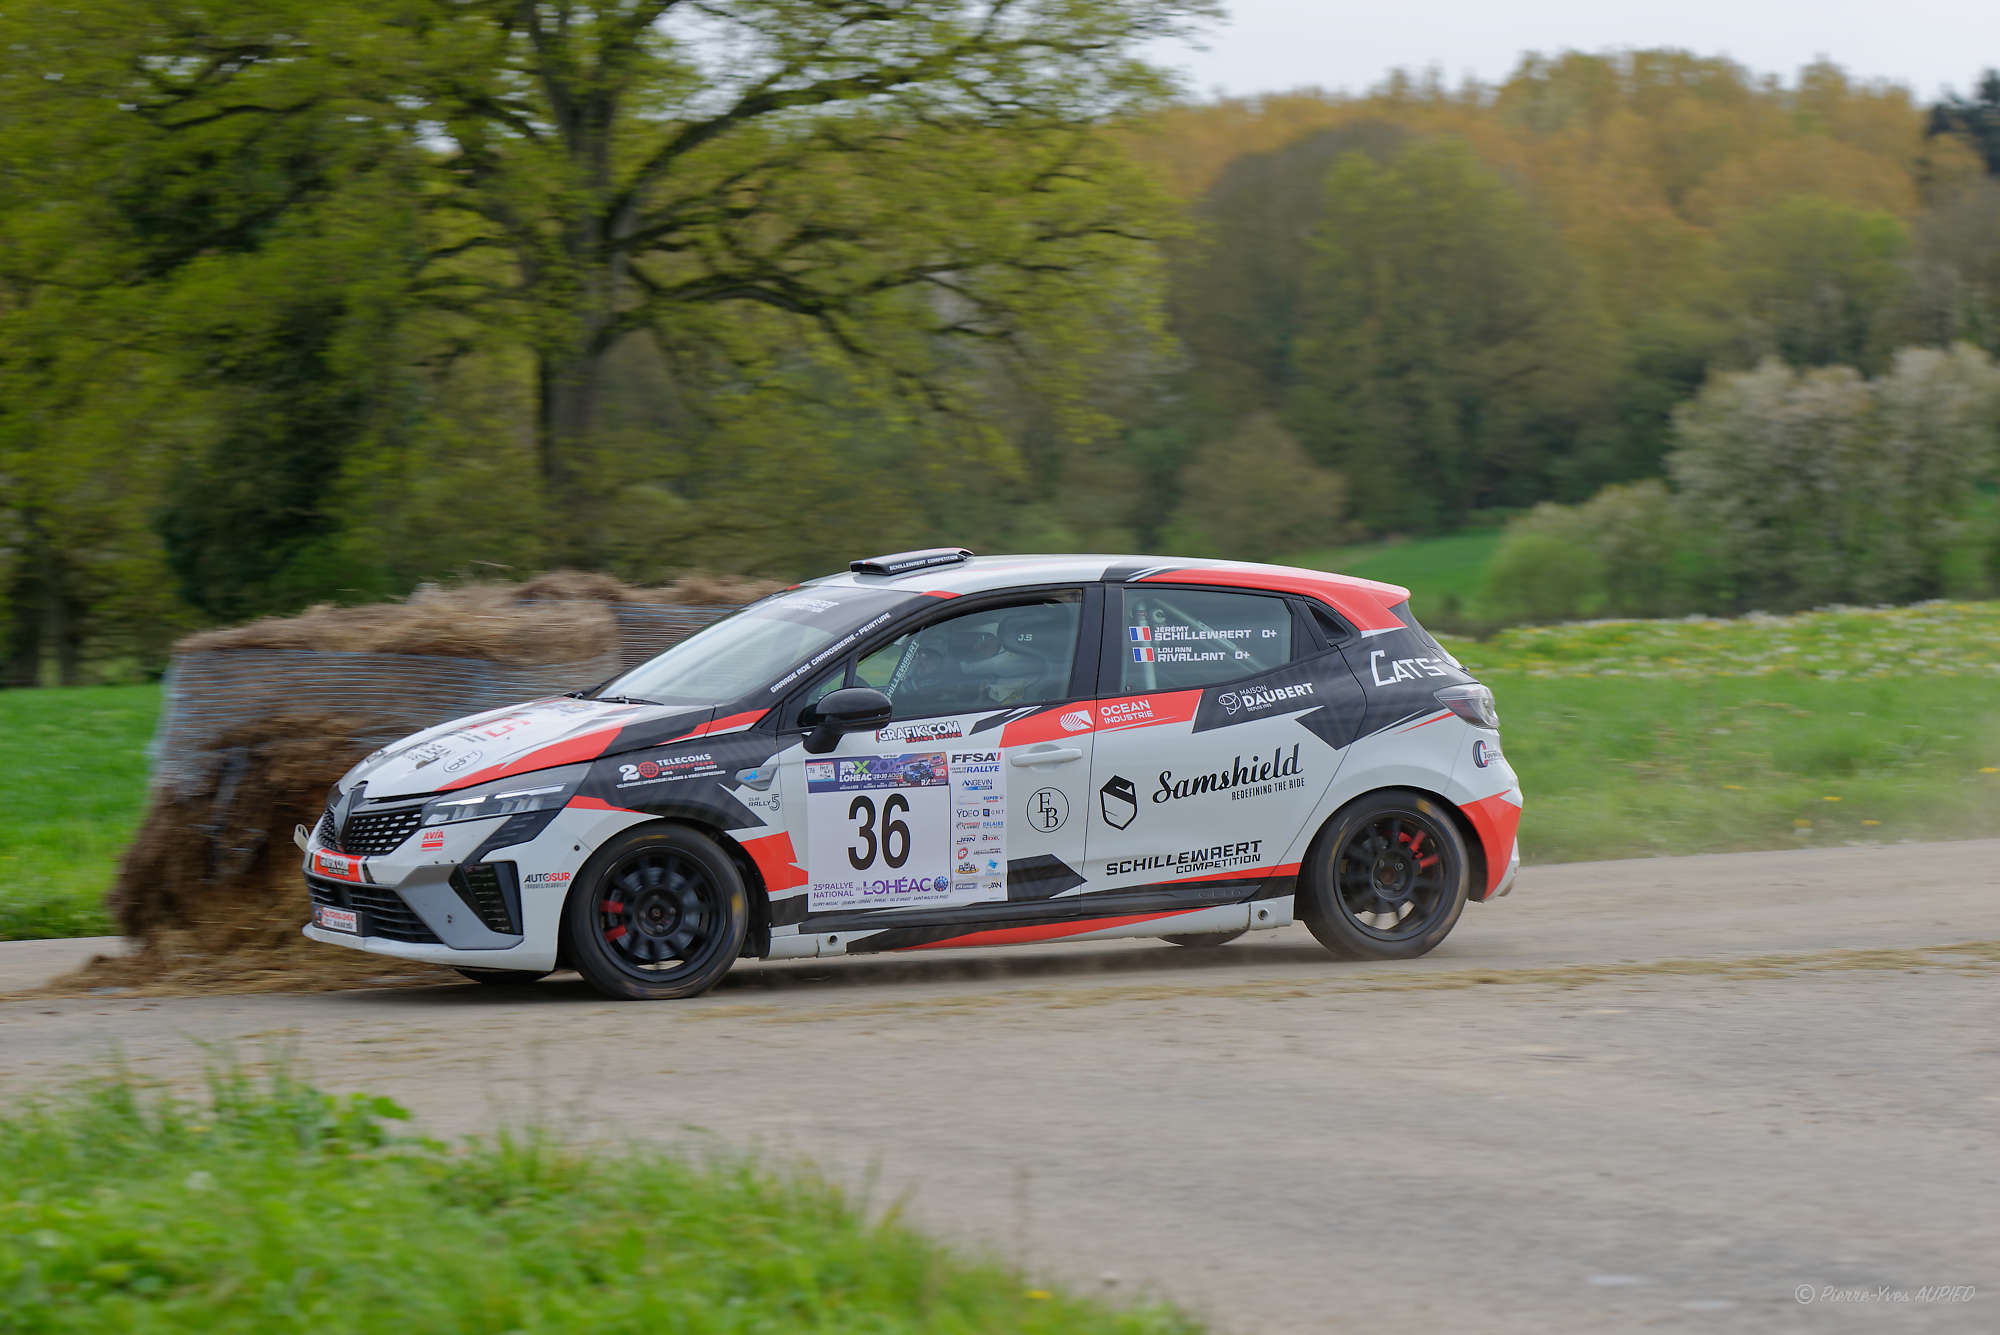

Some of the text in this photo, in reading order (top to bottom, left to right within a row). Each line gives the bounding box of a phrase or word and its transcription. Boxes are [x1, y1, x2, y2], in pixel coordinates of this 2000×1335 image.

[811, 634, 856, 666] CARROSSERIE
[858, 612, 891, 636] PEINTURE
[1155, 630, 1252, 641] SCHILLEWAERT
[1158, 652, 1226, 662] RIVALLANT
[1240, 685, 1268, 697] MAISON
[1242, 683, 1314, 707] DAUBERT
[1101, 700, 1151, 716] OCEAN
[1104, 711, 1153, 724] INDUSTRIE
[656, 754, 713, 768] TELECOMS
[951, 752, 996, 764] FFSA
[966, 765, 1000, 773] RALLYE
[1152, 743, 1304, 803] Samshield
[1231, 777, 1305, 801] REDEFINING THE RIDE
[423, 831, 445, 841] AVIA
[847, 793, 912, 871] 36
[1105, 839, 1263, 876] SCHILLEWAERT
[1175, 853, 1261, 875] COMPETITION
[524, 872, 571, 884] AUTOSUR
[825, 881, 854, 890] RALLYE
[863, 877, 931, 895] LOHÉAC
[813, 890, 854, 899] NATIONAL
